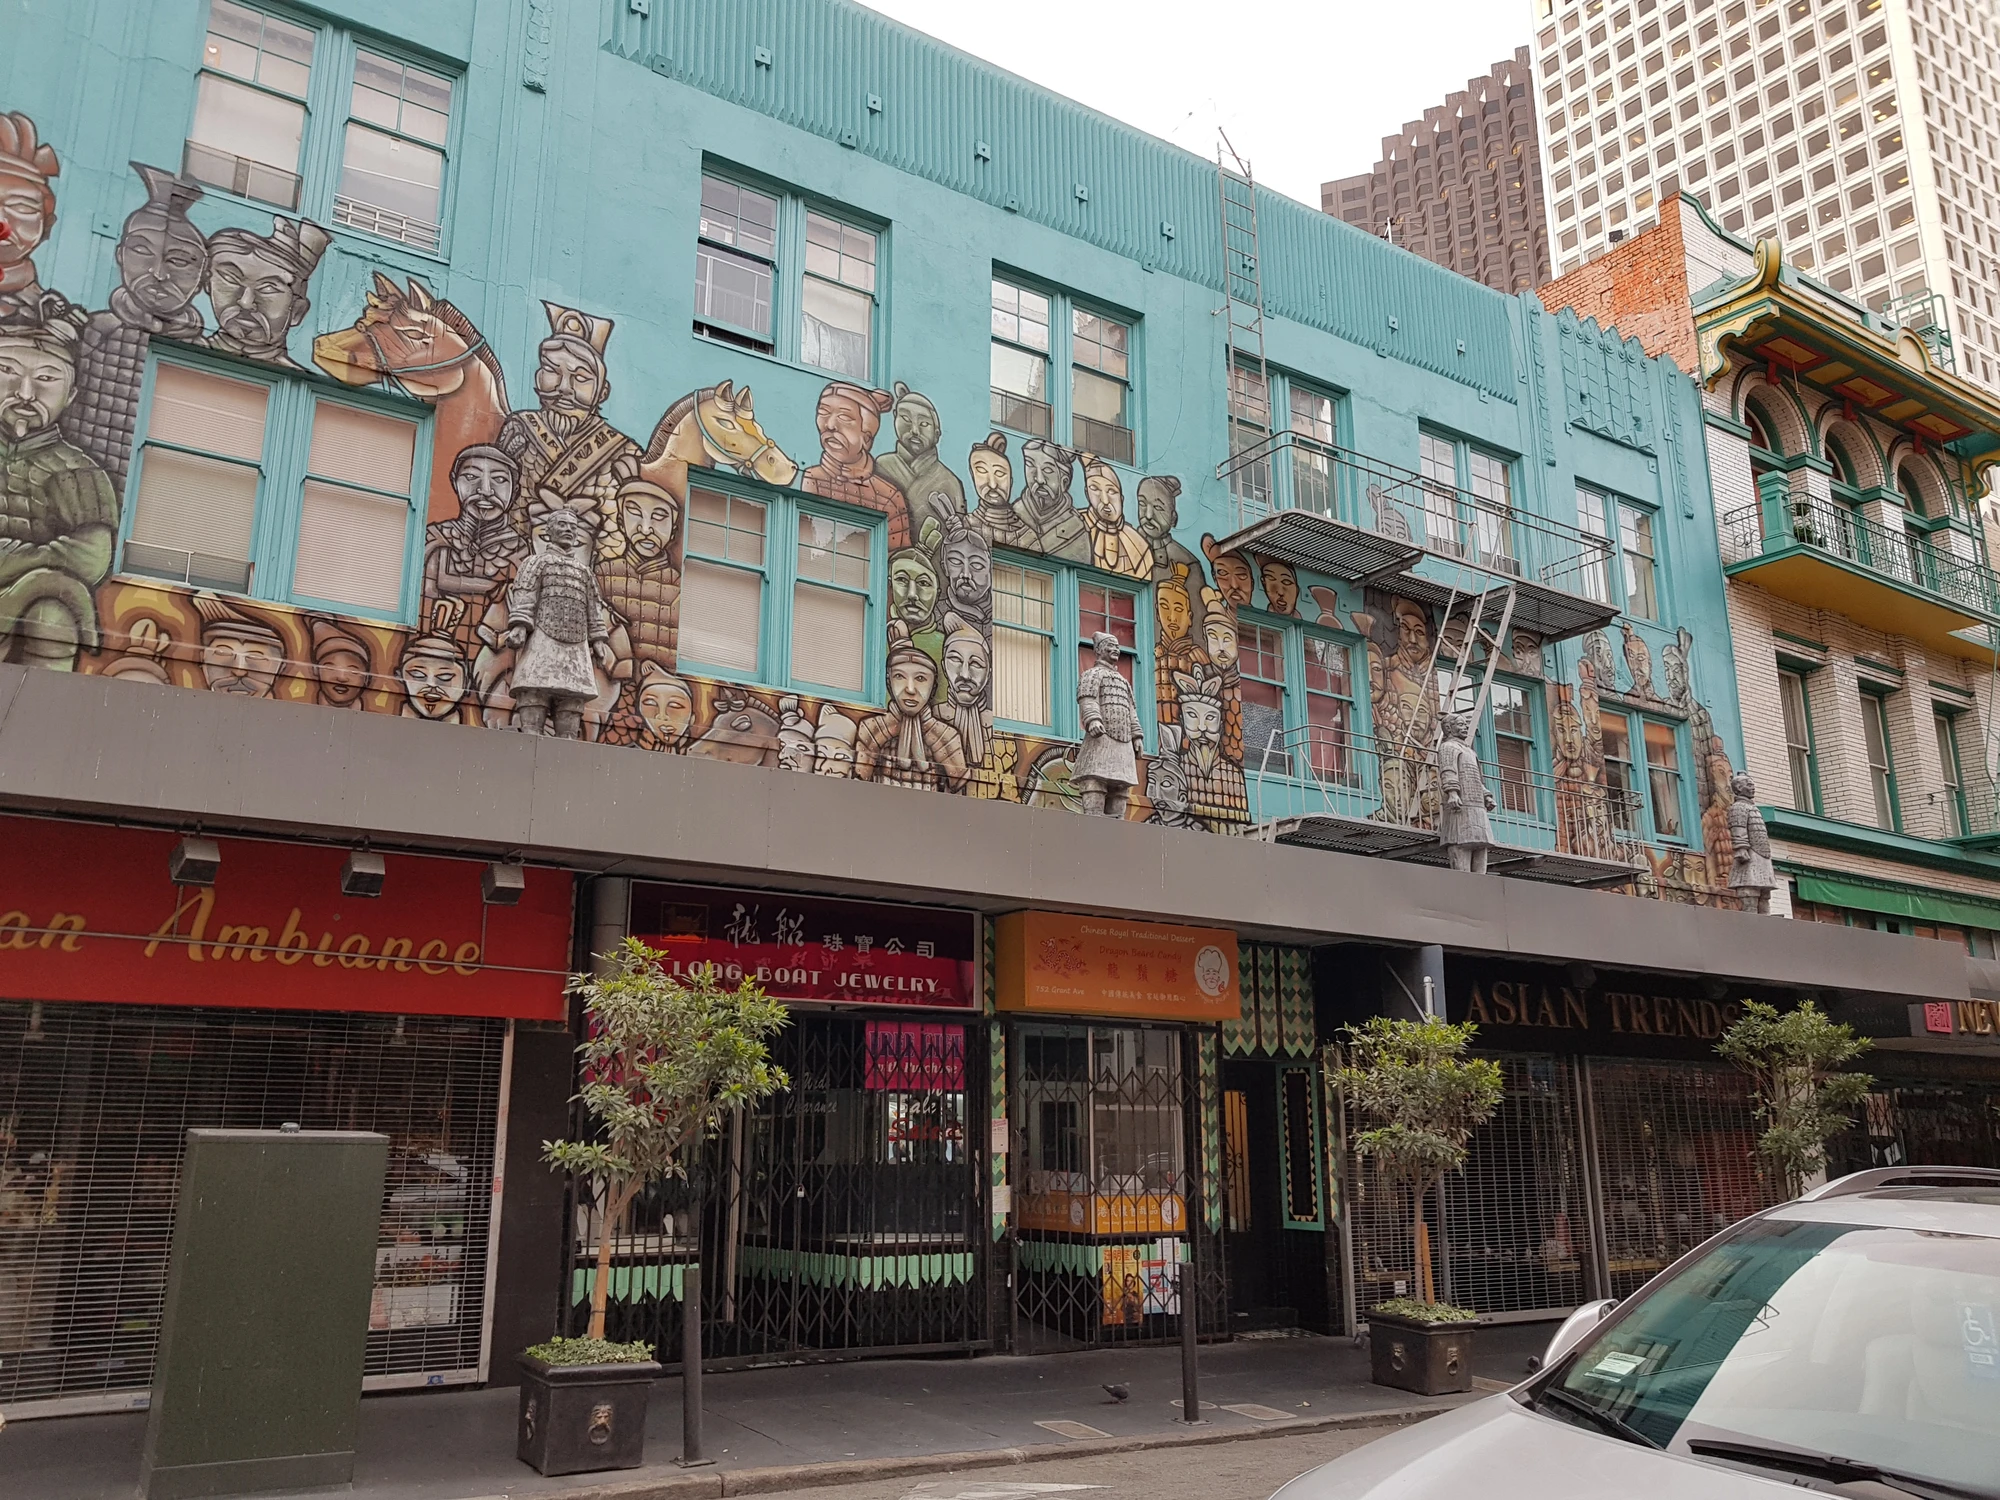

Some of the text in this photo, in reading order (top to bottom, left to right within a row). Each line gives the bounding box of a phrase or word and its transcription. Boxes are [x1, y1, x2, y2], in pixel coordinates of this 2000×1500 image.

[144, 886, 481, 976] Ambiance
[1080, 925, 1196, 944] Chinese Royal Traditional Dessert
[1099, 945, 1182, 963] Dragon Beard Candy
[757, 966, 822, 985] BOAT
[833, 972, 939, 993] JEWELRY
[1035, 985, 1085, 995] 752 Grant Ave
[1465, 980, 1741, 1040] ASIAN TRENDS
